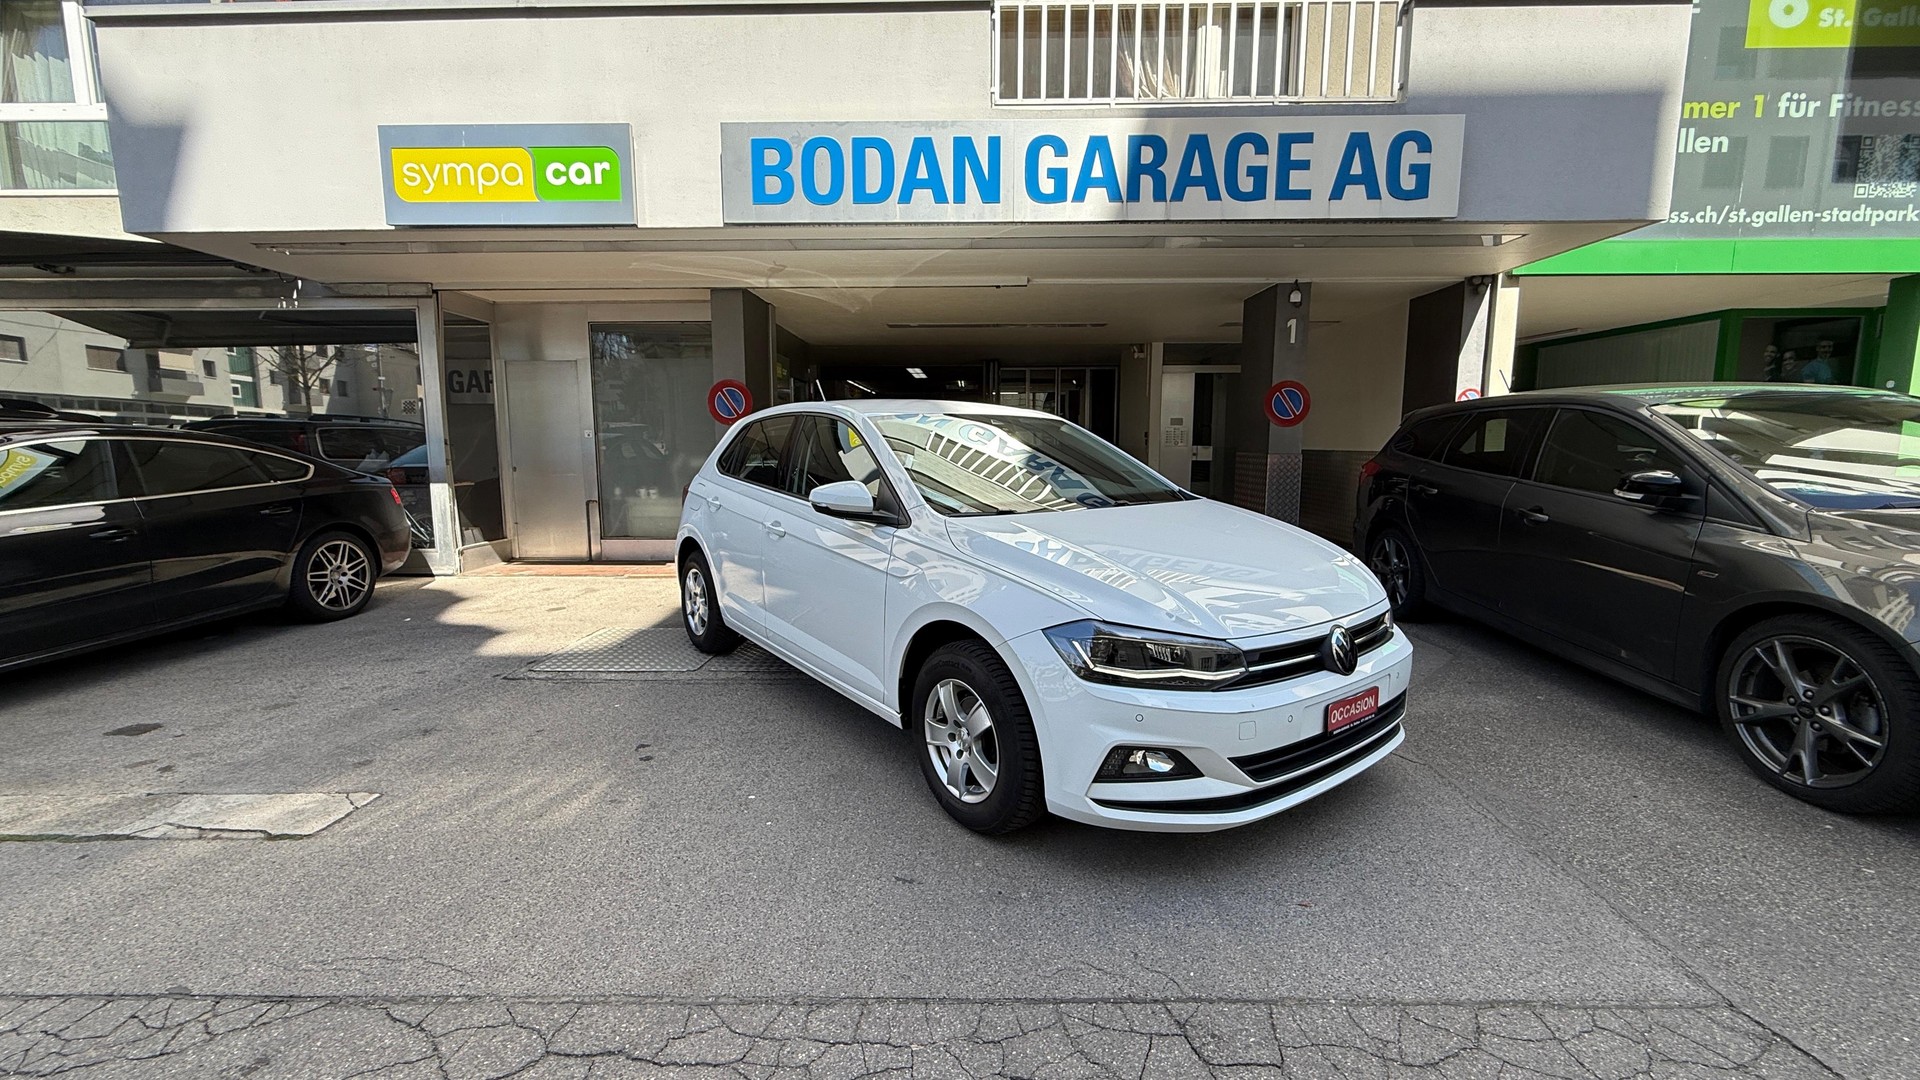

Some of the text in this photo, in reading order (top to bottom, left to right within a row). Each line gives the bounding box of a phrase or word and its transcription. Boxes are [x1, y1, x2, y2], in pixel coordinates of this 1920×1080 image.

[1819, 6, 1920, 28] St. Gall
[1683, 101, 1741, 119] mer
[1754, 95, 1765, 118] 1
[1778, 92, 1821, 118] für
[1677, 128, 1729, 153] llen
[402, 161, 611, 195] sympa car
[750, 129, 1433, 206] BODAN GARAGE AG
[1663, 204, 1920, 226] ss.ch/st.gallen-stadtpark
[1287, 318, 1297, 344] 1
[1330, 694, 1376, 724] OCCASION
